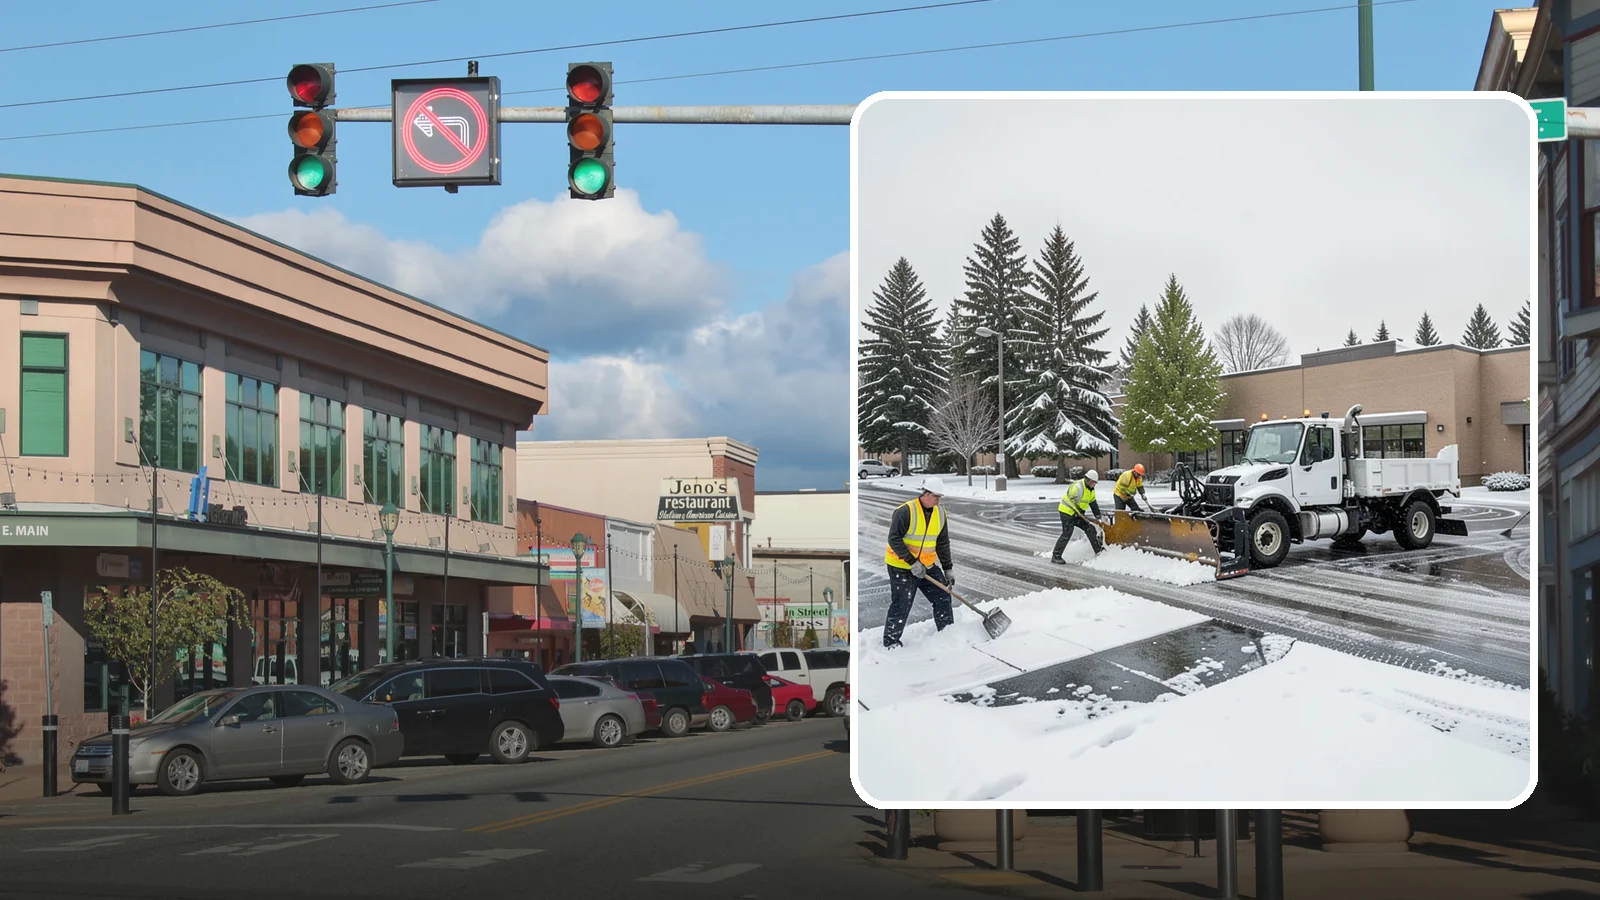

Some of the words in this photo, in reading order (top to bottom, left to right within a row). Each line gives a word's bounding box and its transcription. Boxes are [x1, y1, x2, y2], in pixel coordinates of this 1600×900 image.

[670, 480, 727, 494] Jeno's
[665, 496, 730, 508] restaurant
[658, 510, 681, 519] Italian
[686, 510, 714, 519] American
[715, 510, 738, 519] Cuisine
[2, 526, 12, 536] E.
[16, 526, 48, 536] MAIN
[798, 608, 828, 616] Street
